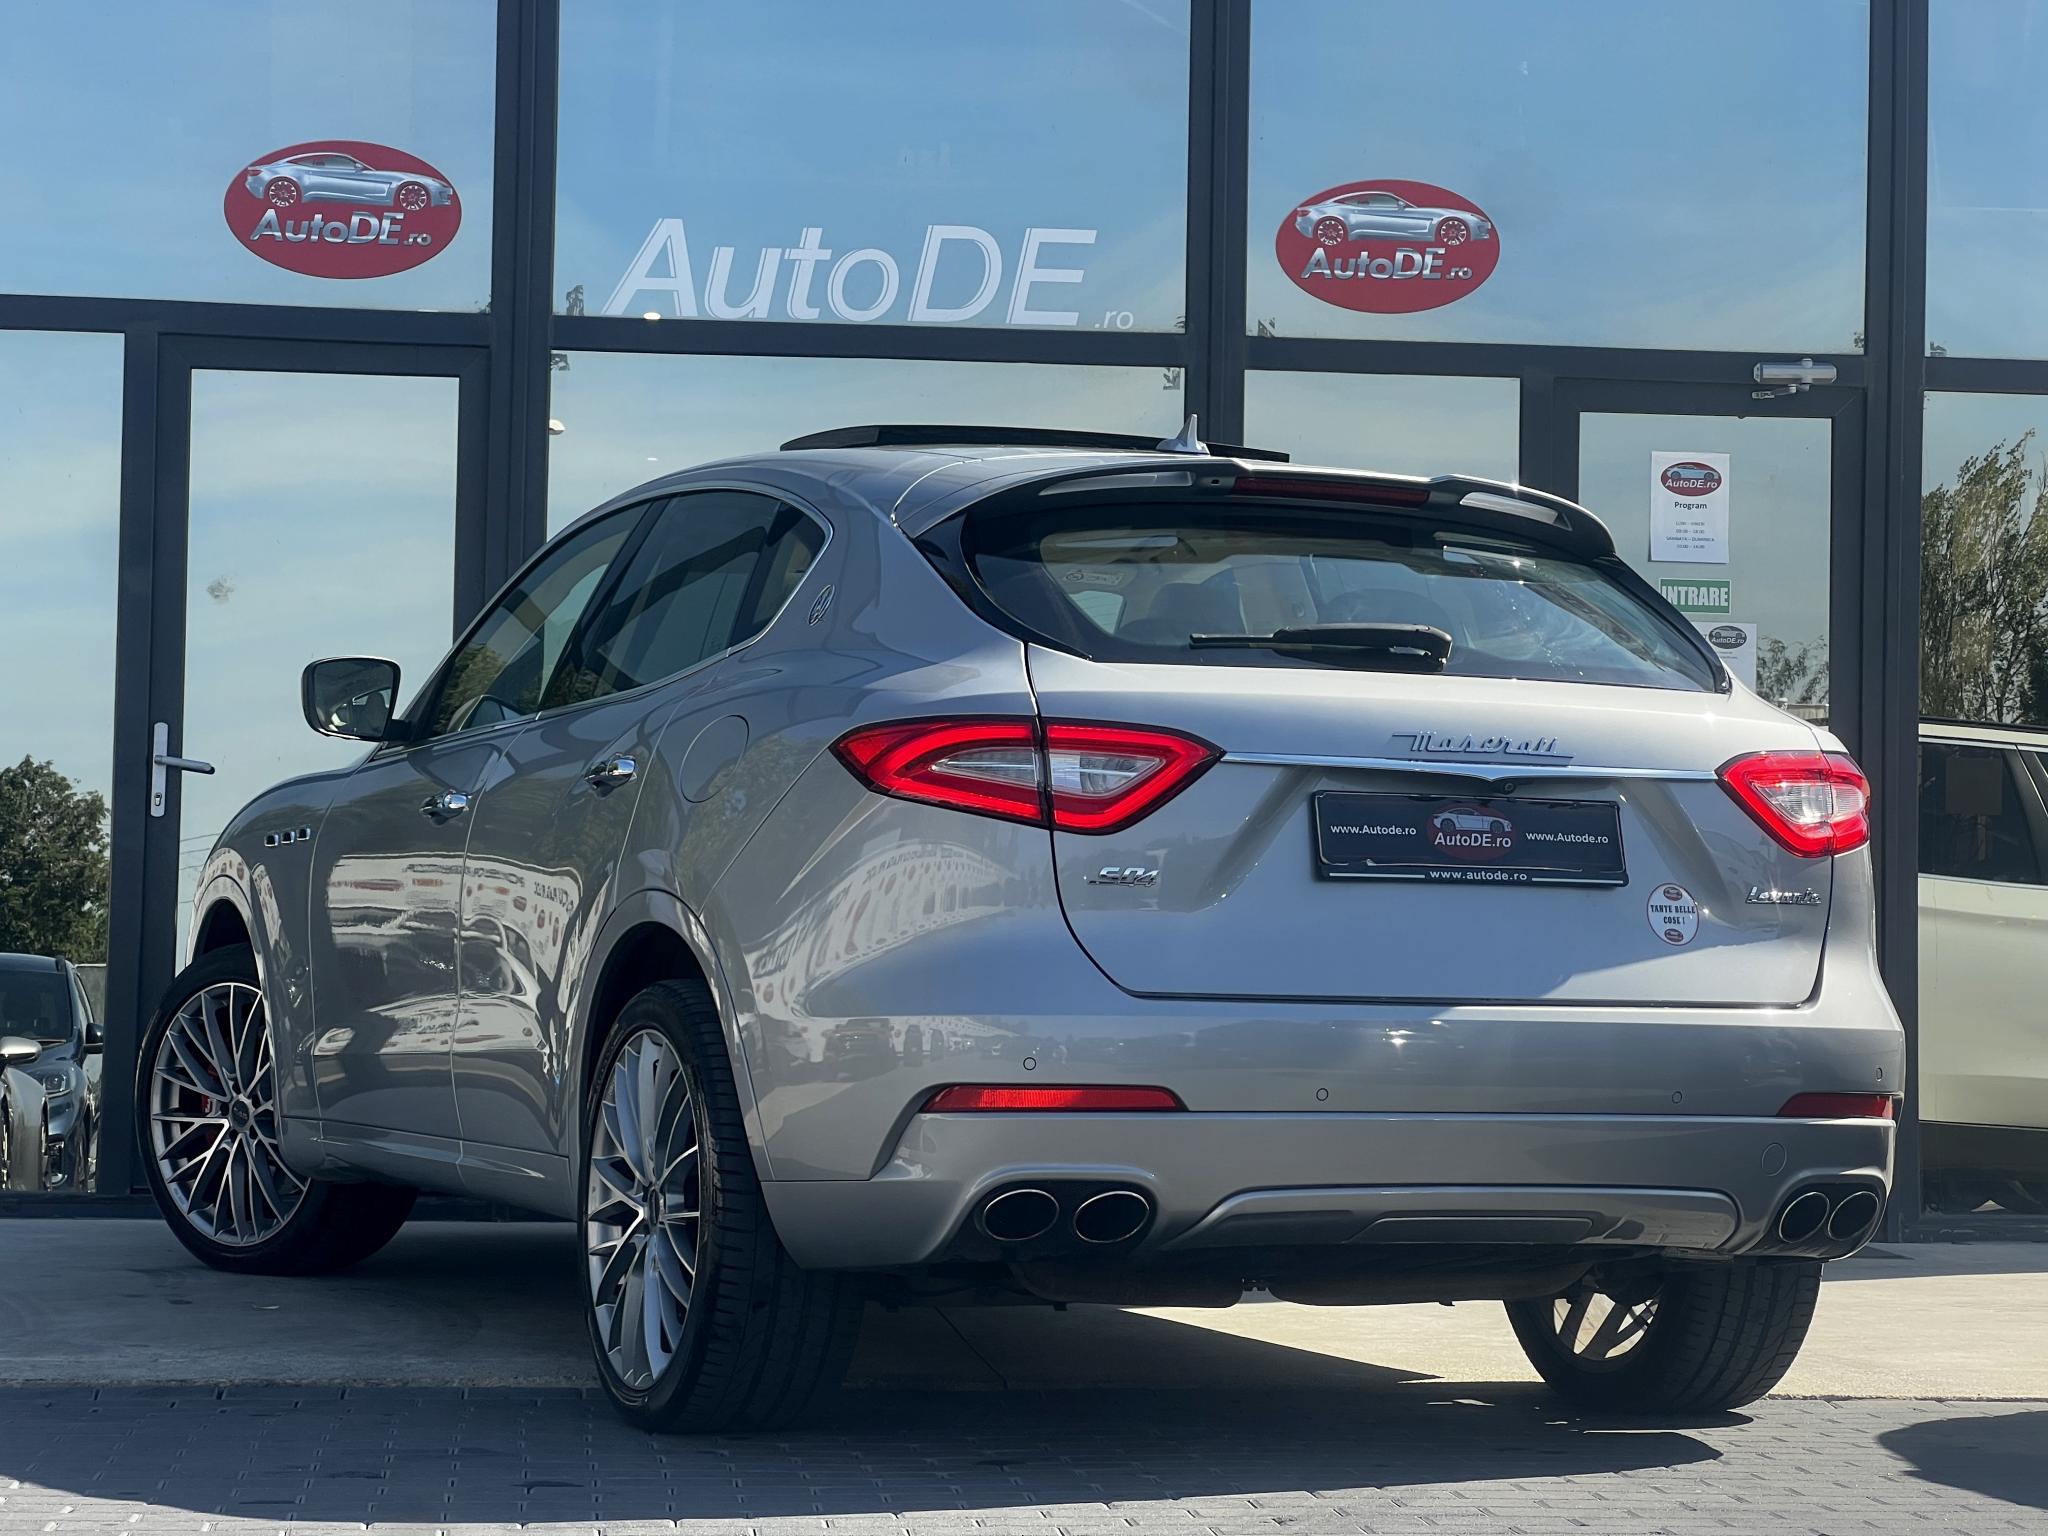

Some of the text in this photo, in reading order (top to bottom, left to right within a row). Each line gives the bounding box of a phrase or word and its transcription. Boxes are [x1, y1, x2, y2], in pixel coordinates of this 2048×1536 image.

[1665, 479, 1718, 489] AutoDE.ro
[1674, 501, 1708, 510] Program
[1661, 586, 1729, 606] INTRARE
[1330, 825, 1417, 836] www.Autode.ro
[1434, 832, 1512, 848] AutoDE.ro
[1525, 831, 1609, 844] www.Autode.ro
[1429, 869, 1528, 882] www.autode.ro
